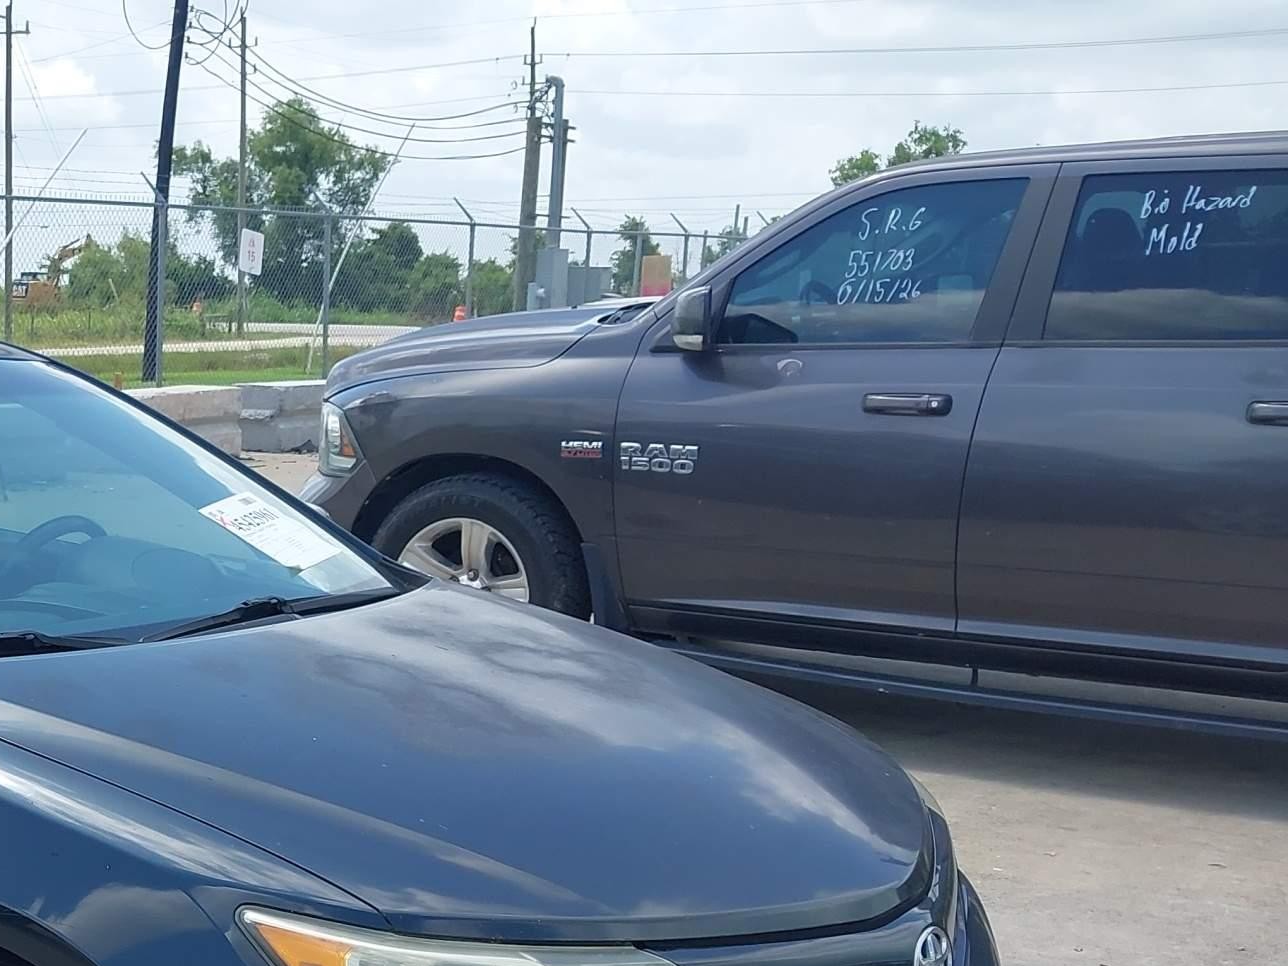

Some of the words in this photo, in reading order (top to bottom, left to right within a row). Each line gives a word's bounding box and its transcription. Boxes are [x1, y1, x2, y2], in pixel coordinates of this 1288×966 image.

[1181, 185, 1257, 214] Hazard
[1145, 222, 1203, 255] Mold
[561, 441, 603, 449] HEMI
[620, 442, 699, 459] RAM
[620, 456, 694, 474] 1500
